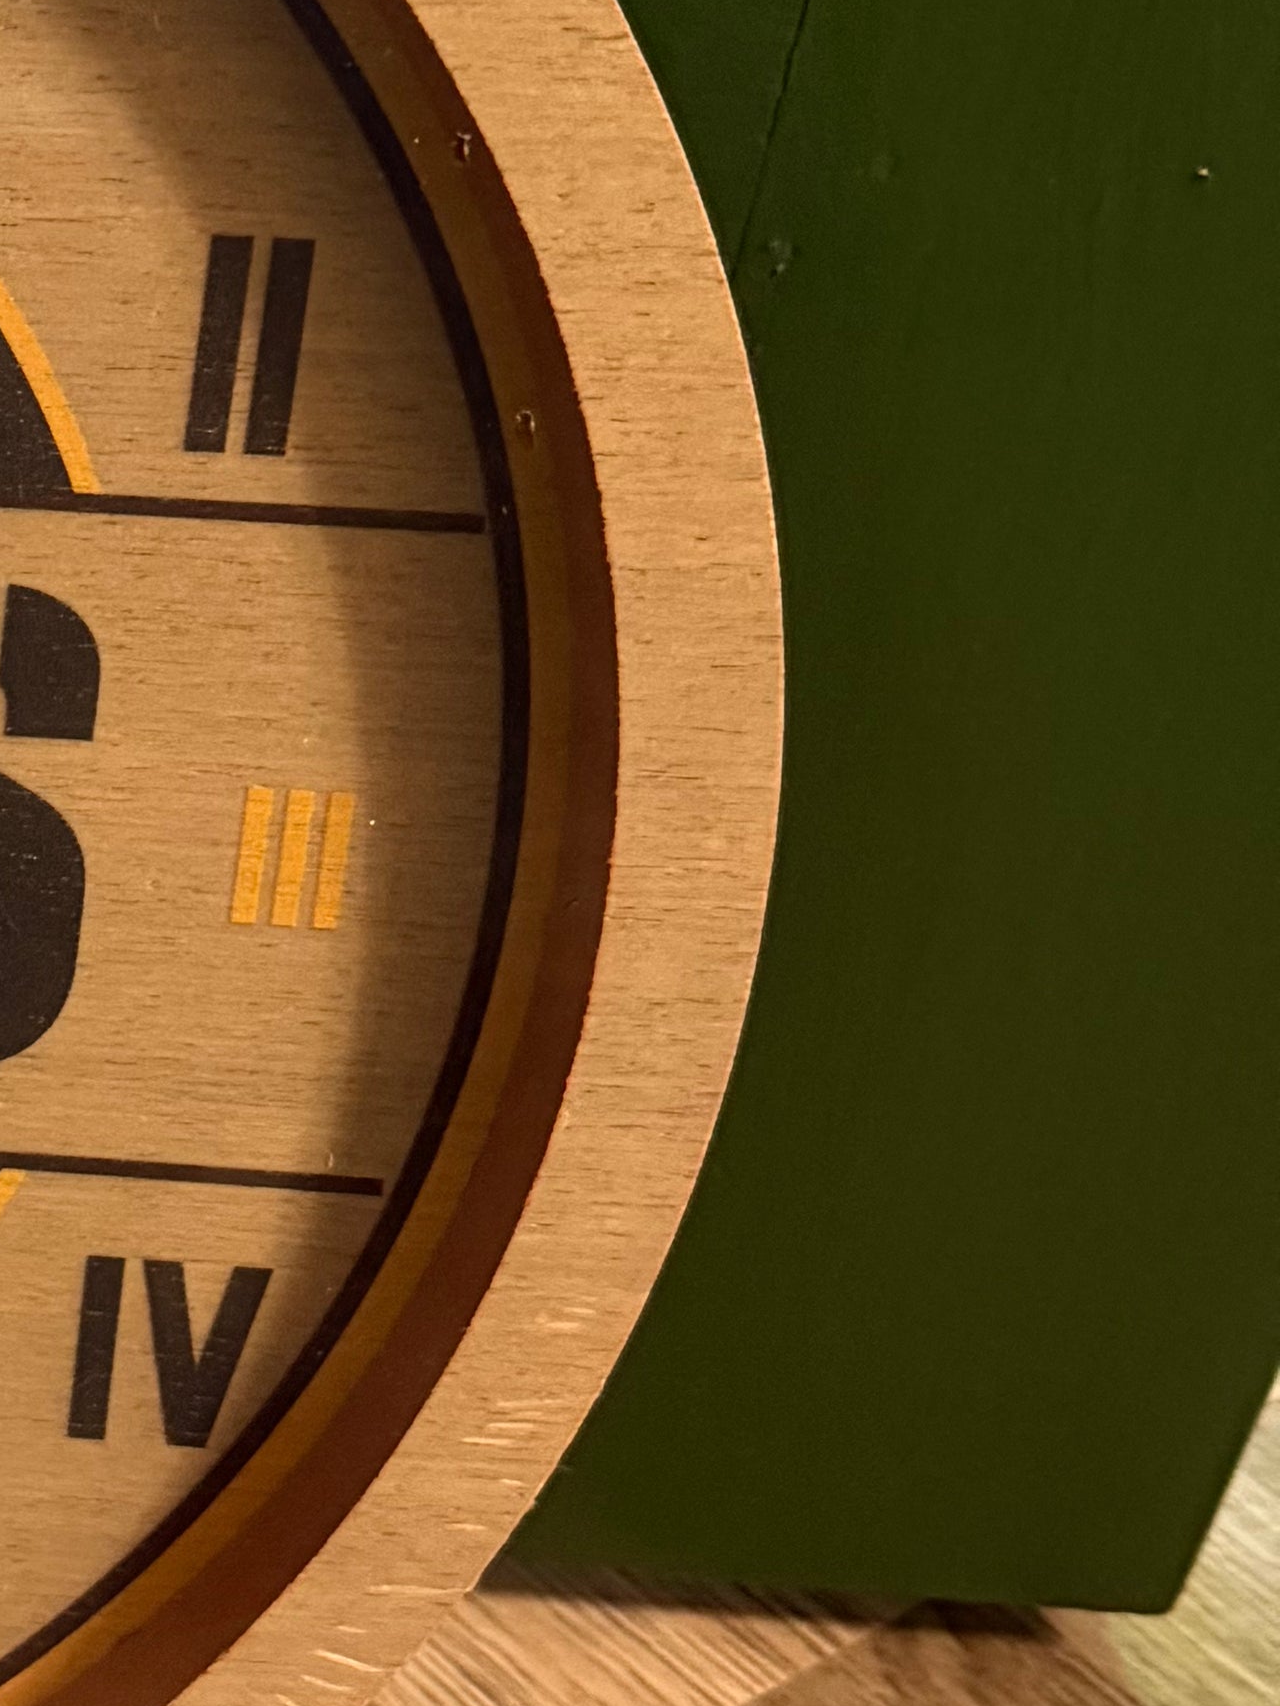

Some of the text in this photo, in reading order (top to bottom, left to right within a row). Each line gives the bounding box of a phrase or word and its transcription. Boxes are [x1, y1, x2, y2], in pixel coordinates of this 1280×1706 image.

[184, 235, 315, 456] II
[230, 785, 355, 930] III
[67, 1255, 273, 1449] IV
